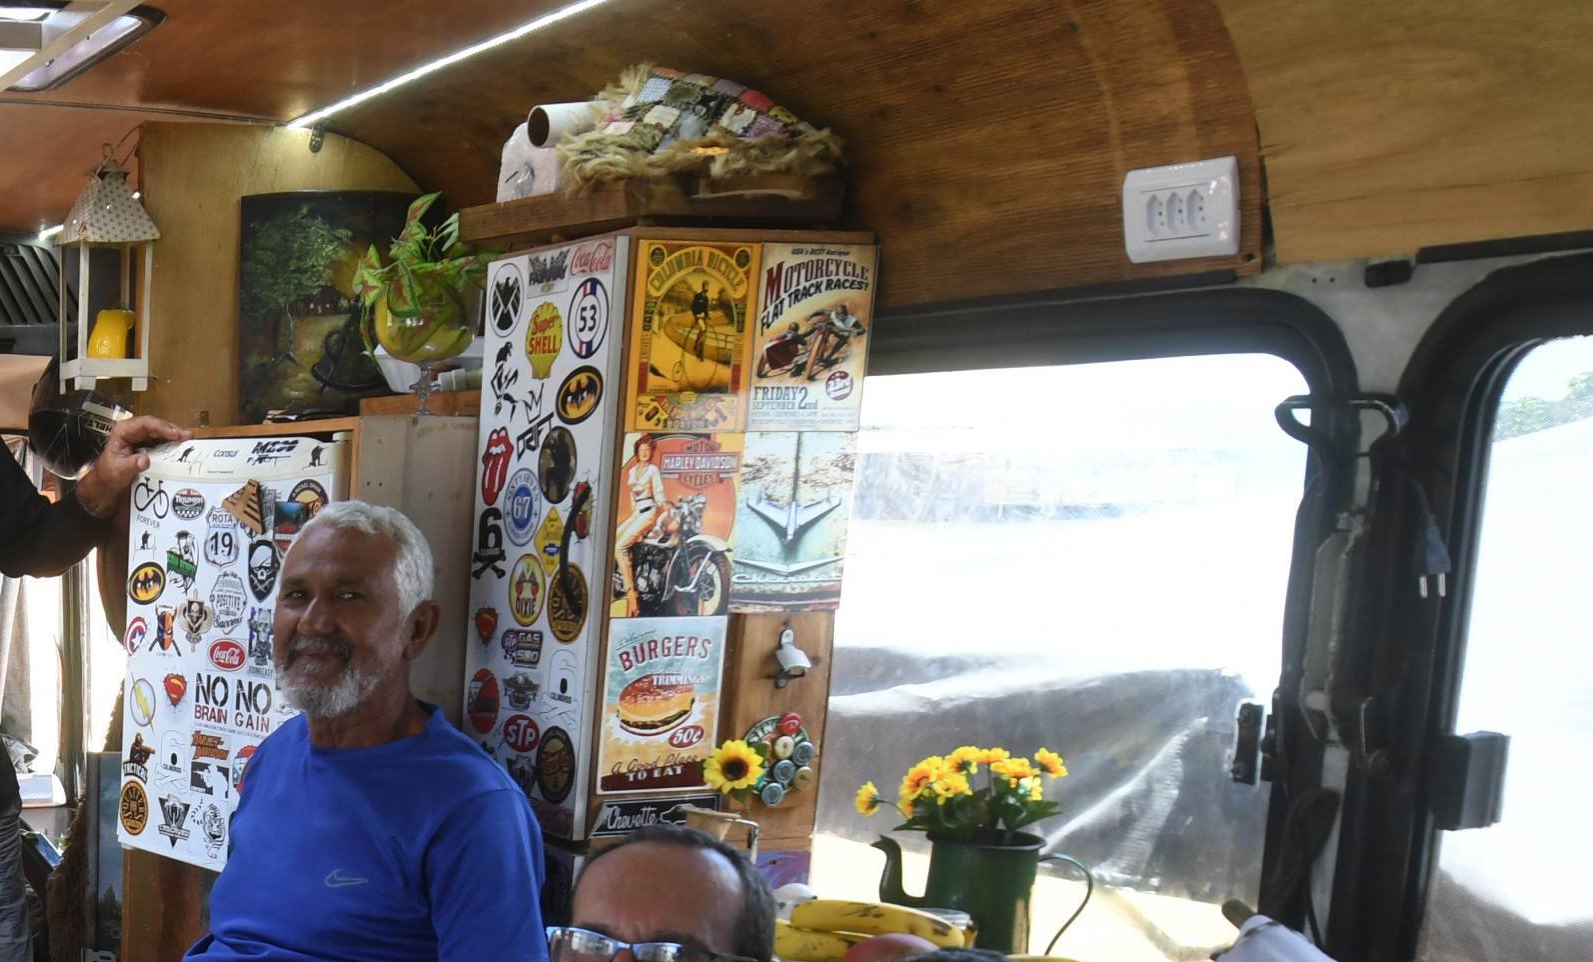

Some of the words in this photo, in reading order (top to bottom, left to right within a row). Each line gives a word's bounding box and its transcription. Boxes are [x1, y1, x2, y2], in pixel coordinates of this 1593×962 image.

[578, 304, 598, 333] 53
[761, 298, 785, 336] FLAT
[787, 280, 823, 308] TRACK
[528, 336, 558, 356] SHELL
[753, 386, 799, 401] FRIDAY
[753, 401, 795, 410] SEPTEMBER
[513, 495, 531, 519] 67
[137, 514, 160, 528] FOREVER
[212, 513, 233, 523] ROTA
[479, 507, 503, 551] 6
[210, 531, 233, 556] 19
[518, 632, 540, 642] GAS
[618, 636, 712, 672] BURGERS
[195, 672, 229, 708] NO
[652, 674, 706, 686] TRIMMINGS
[235, 679, 272, 715] NO
[194, 704, 228, 725] BRAIN
[234, 712, 270, 733] GAIN
[507, 718, 537, 747] STP
[627, 757, 660, 773] Good
[663, 752, 699, 768] Place
[627, 772, 648, 782] TO
[653, 766, 683, 779] EAT
[606, 805, 658, 830] Chevette
